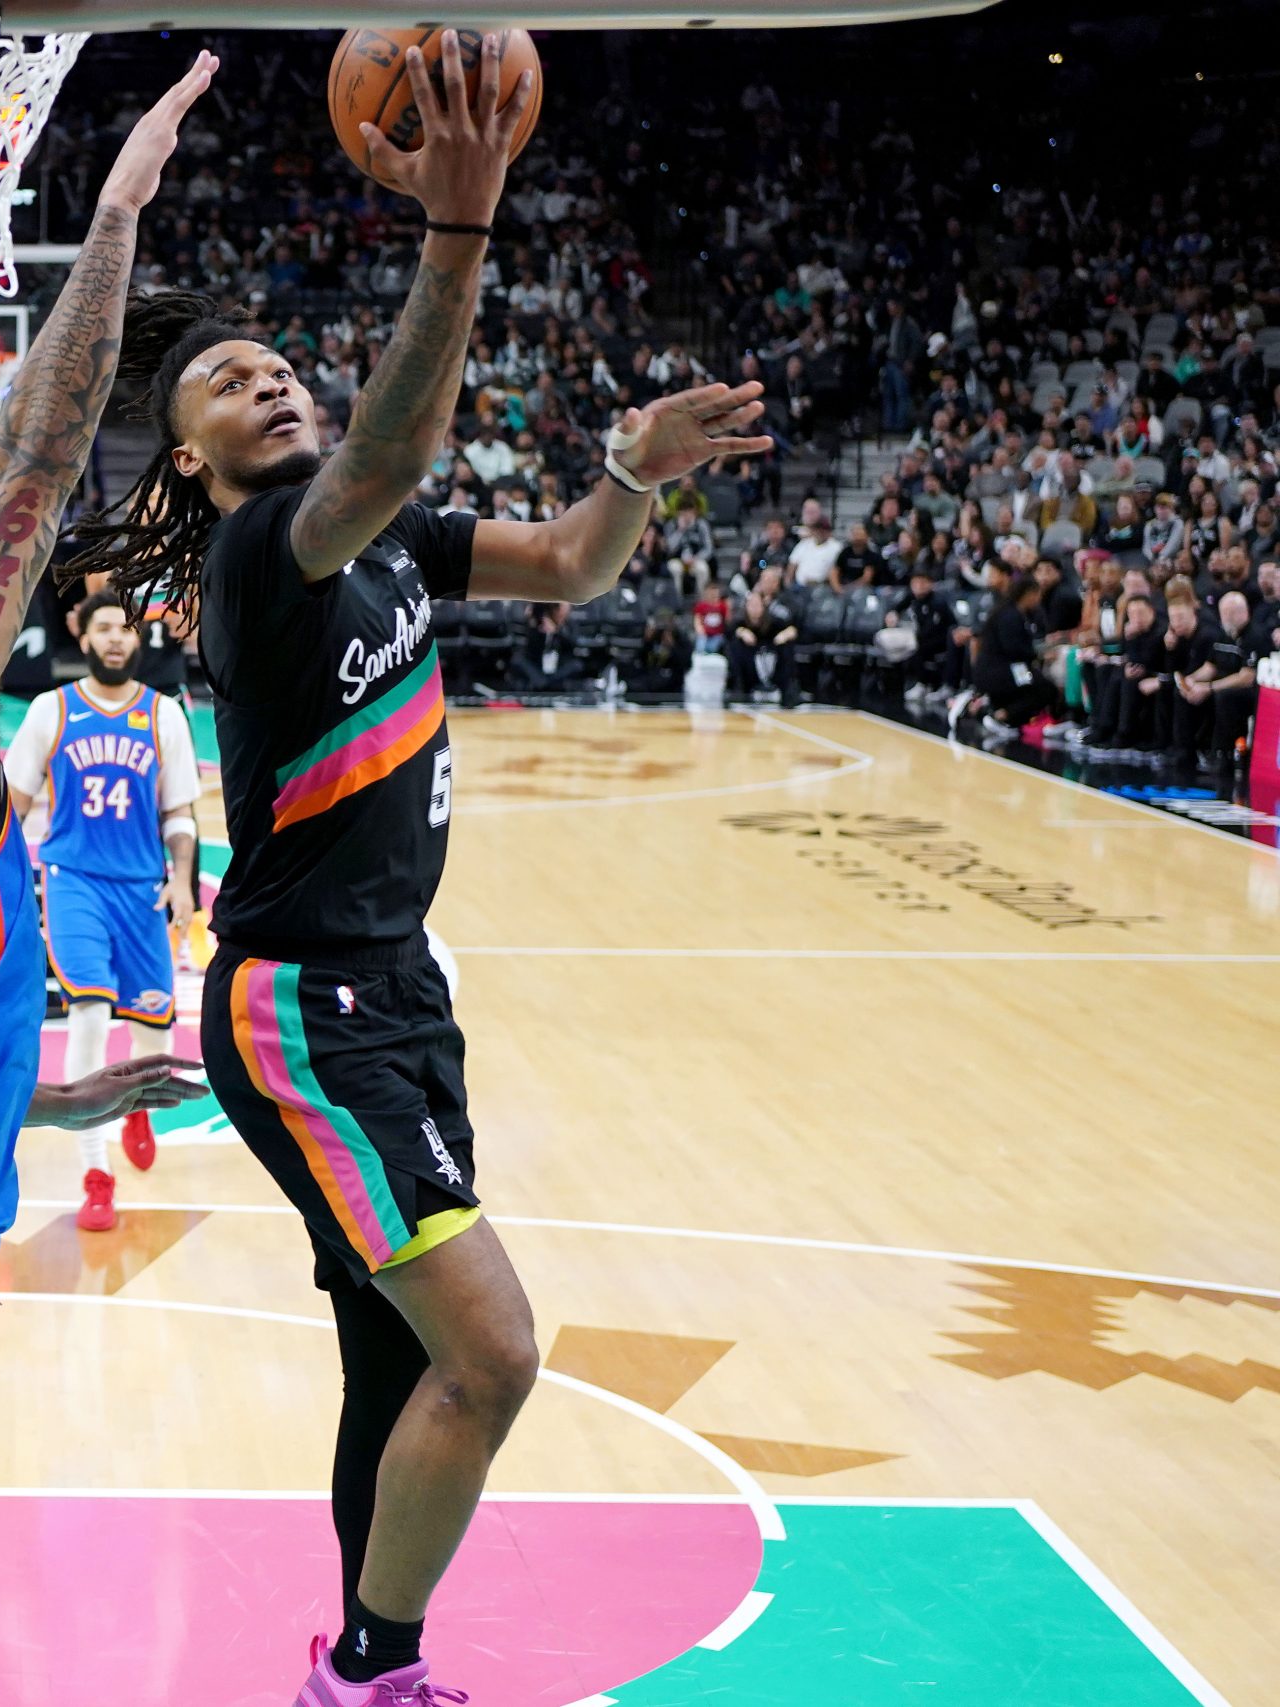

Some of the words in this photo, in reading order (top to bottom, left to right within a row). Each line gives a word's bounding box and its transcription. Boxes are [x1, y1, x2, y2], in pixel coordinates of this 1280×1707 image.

[149, 620, 165, 649] 1
[338, 638, 393, 705] San
[63, 734, 156, 777] THUNDER
[81, 774, 132, 821] 34
[427, 744, 453, 829] 5
